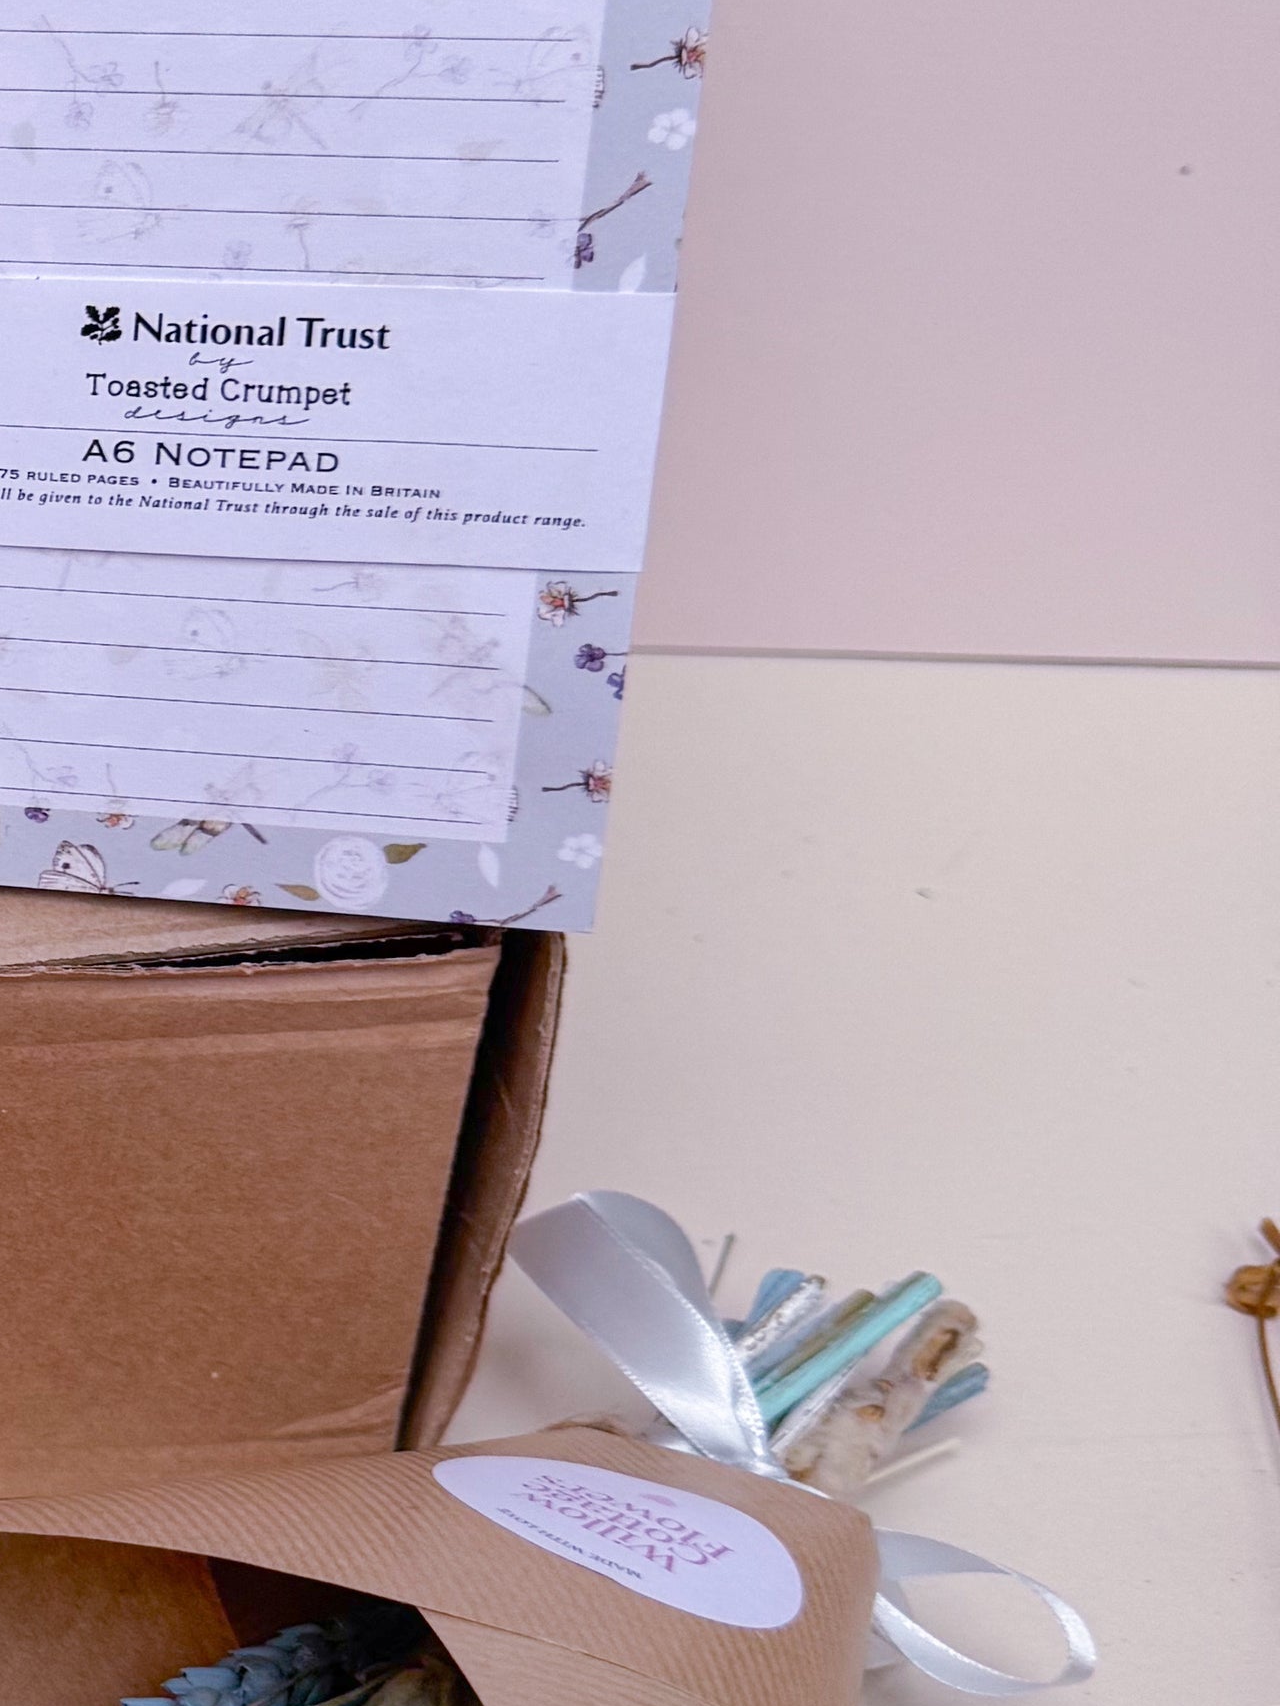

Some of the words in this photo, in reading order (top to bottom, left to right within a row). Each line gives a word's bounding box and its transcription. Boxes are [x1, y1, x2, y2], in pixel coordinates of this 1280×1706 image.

[132, 312, 286, 346] National
[296, 317, 391, 350] Trust
[86, 373, 209, 401] Toasted
[220, 378, 352, 410] Crumpet
[82, 439, 135, 463] A6
[18, 488, 34, 502] be
[39, 490, 81, 506] given
[89, 493, 103, 505] to
[108, 493, 132, 506] the
[139, 495, 207, 511] National
[216, 499, 258, 513] Trust
[264, 501, 328, 519] through
[335, 504, 360, 517] the
[365, 505, 399, 519] sale
[404, 506, 423, 522] of
[426, 507, 457, 522] this
[462, 511, 527, 529] product
[533, 514, 586, 531] range.
[510, 1492, 677, 1573] Willow
[589, 1553, 643, 1579] MADE
